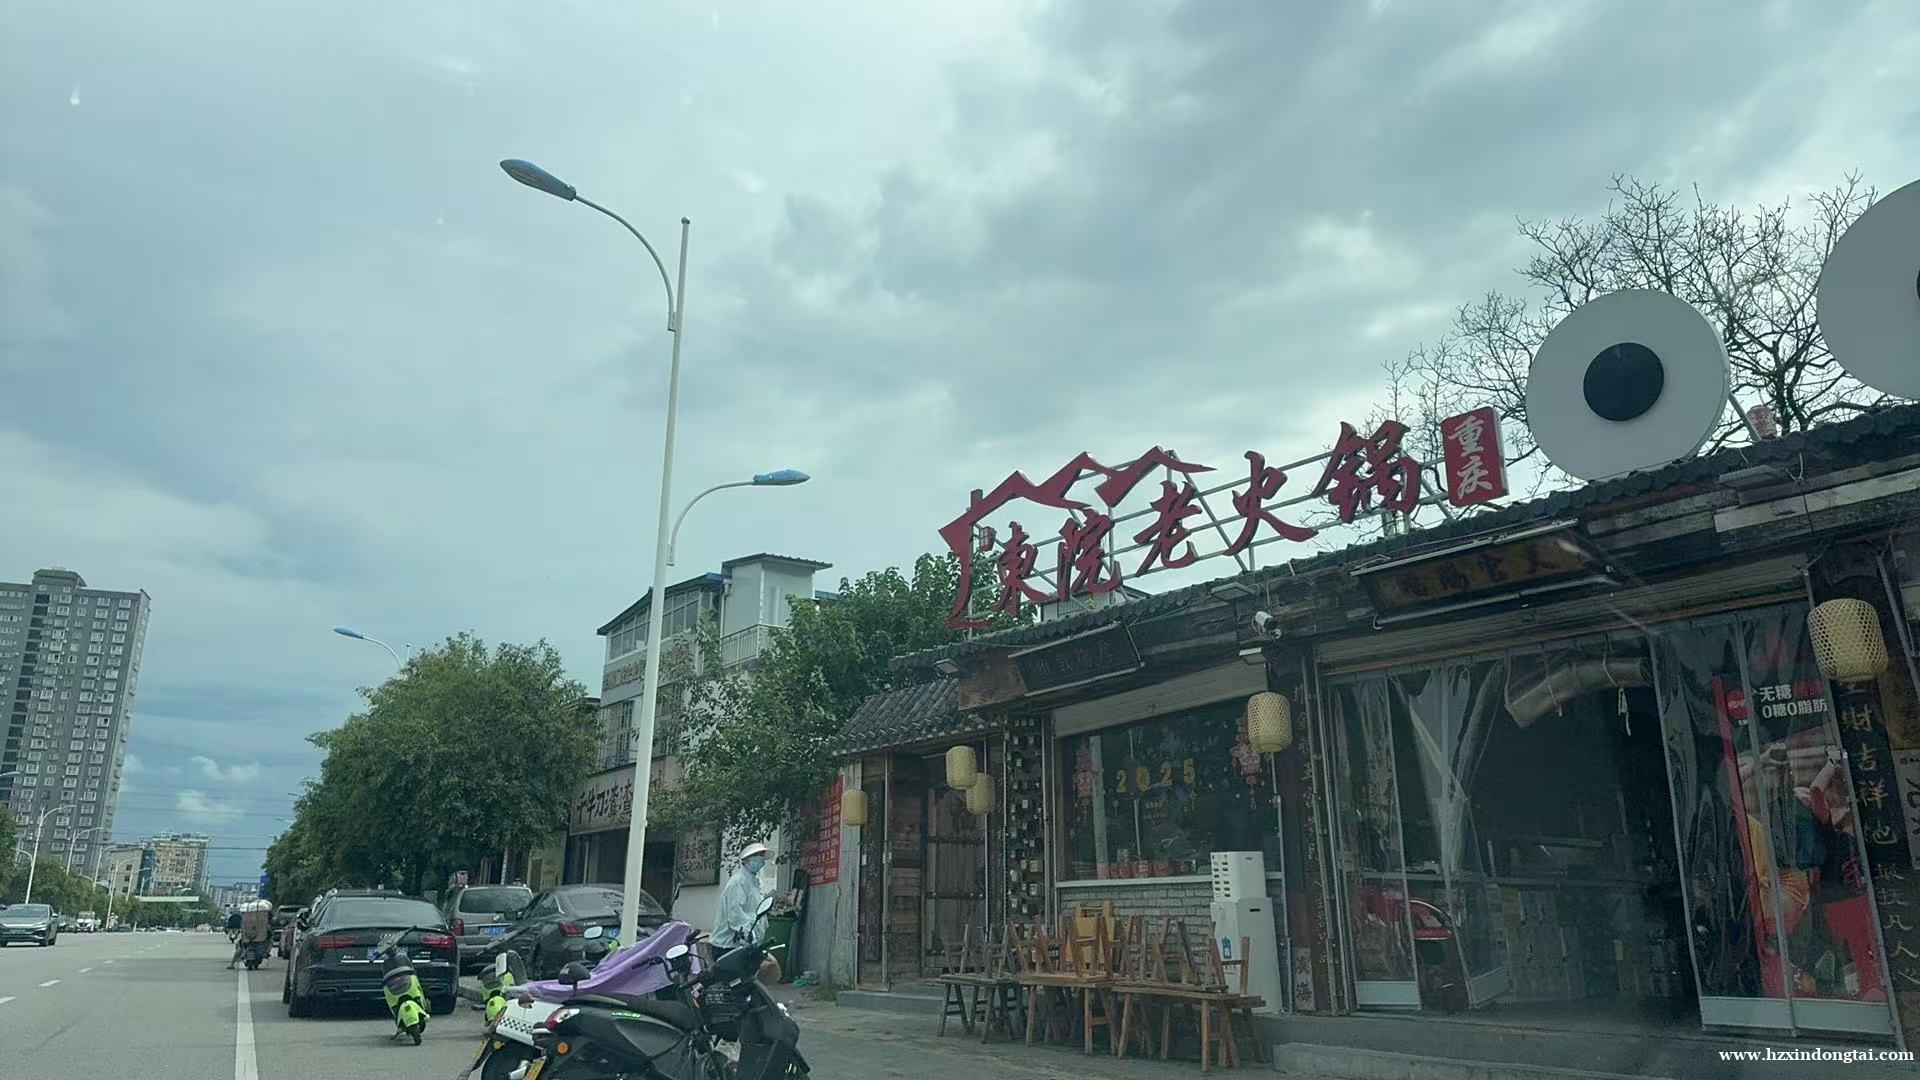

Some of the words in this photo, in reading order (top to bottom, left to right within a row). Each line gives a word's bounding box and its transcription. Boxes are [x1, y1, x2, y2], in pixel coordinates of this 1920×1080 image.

[1448, 415, 1493, 500] 重庆
[1760, 684, 1792, 702] 无糖
[1762, 698, 1828, 719] 0糖0脂肪
[1116, 758, 1196, 793] 2025
